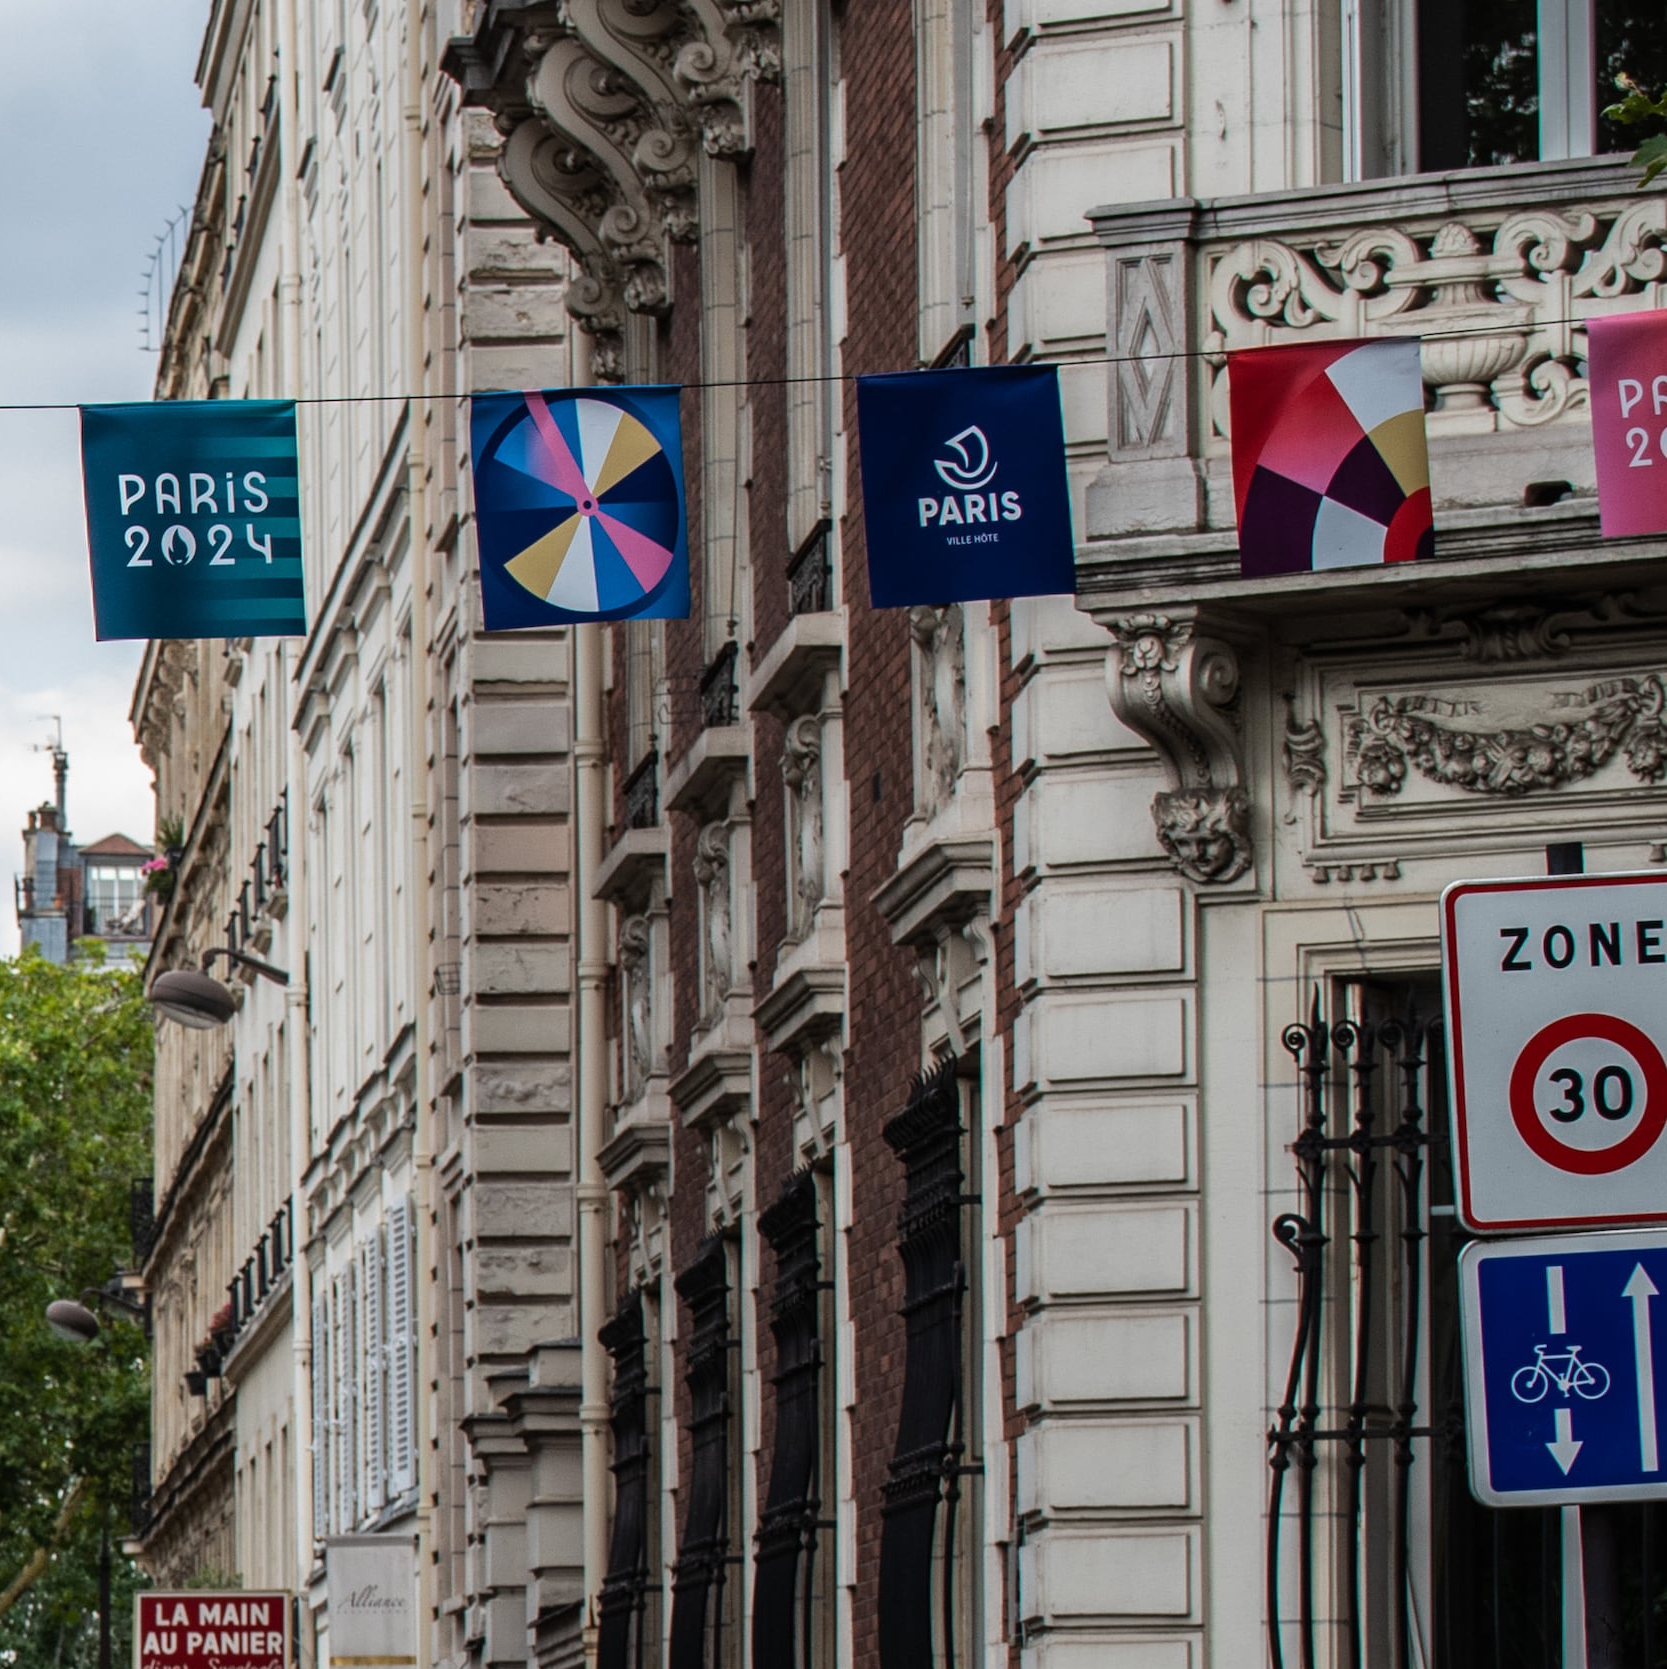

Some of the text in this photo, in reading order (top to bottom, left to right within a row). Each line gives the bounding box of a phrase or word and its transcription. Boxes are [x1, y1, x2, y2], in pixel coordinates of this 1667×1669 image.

[1625, 426, 1667, 468] 2
[917, 490, 1023, 528] PARIS
[124, 523, 273, 568] 2024
[946, 532, 1000, 546] VILLE HÔTE
[1499, 919, 1666, 972] ZONE
[1548, 1065, 1634, 1124] 30
[155, 1602, 270, 1627] LA MAIN
[142, 1631, 284, 1656] AU PANIER
